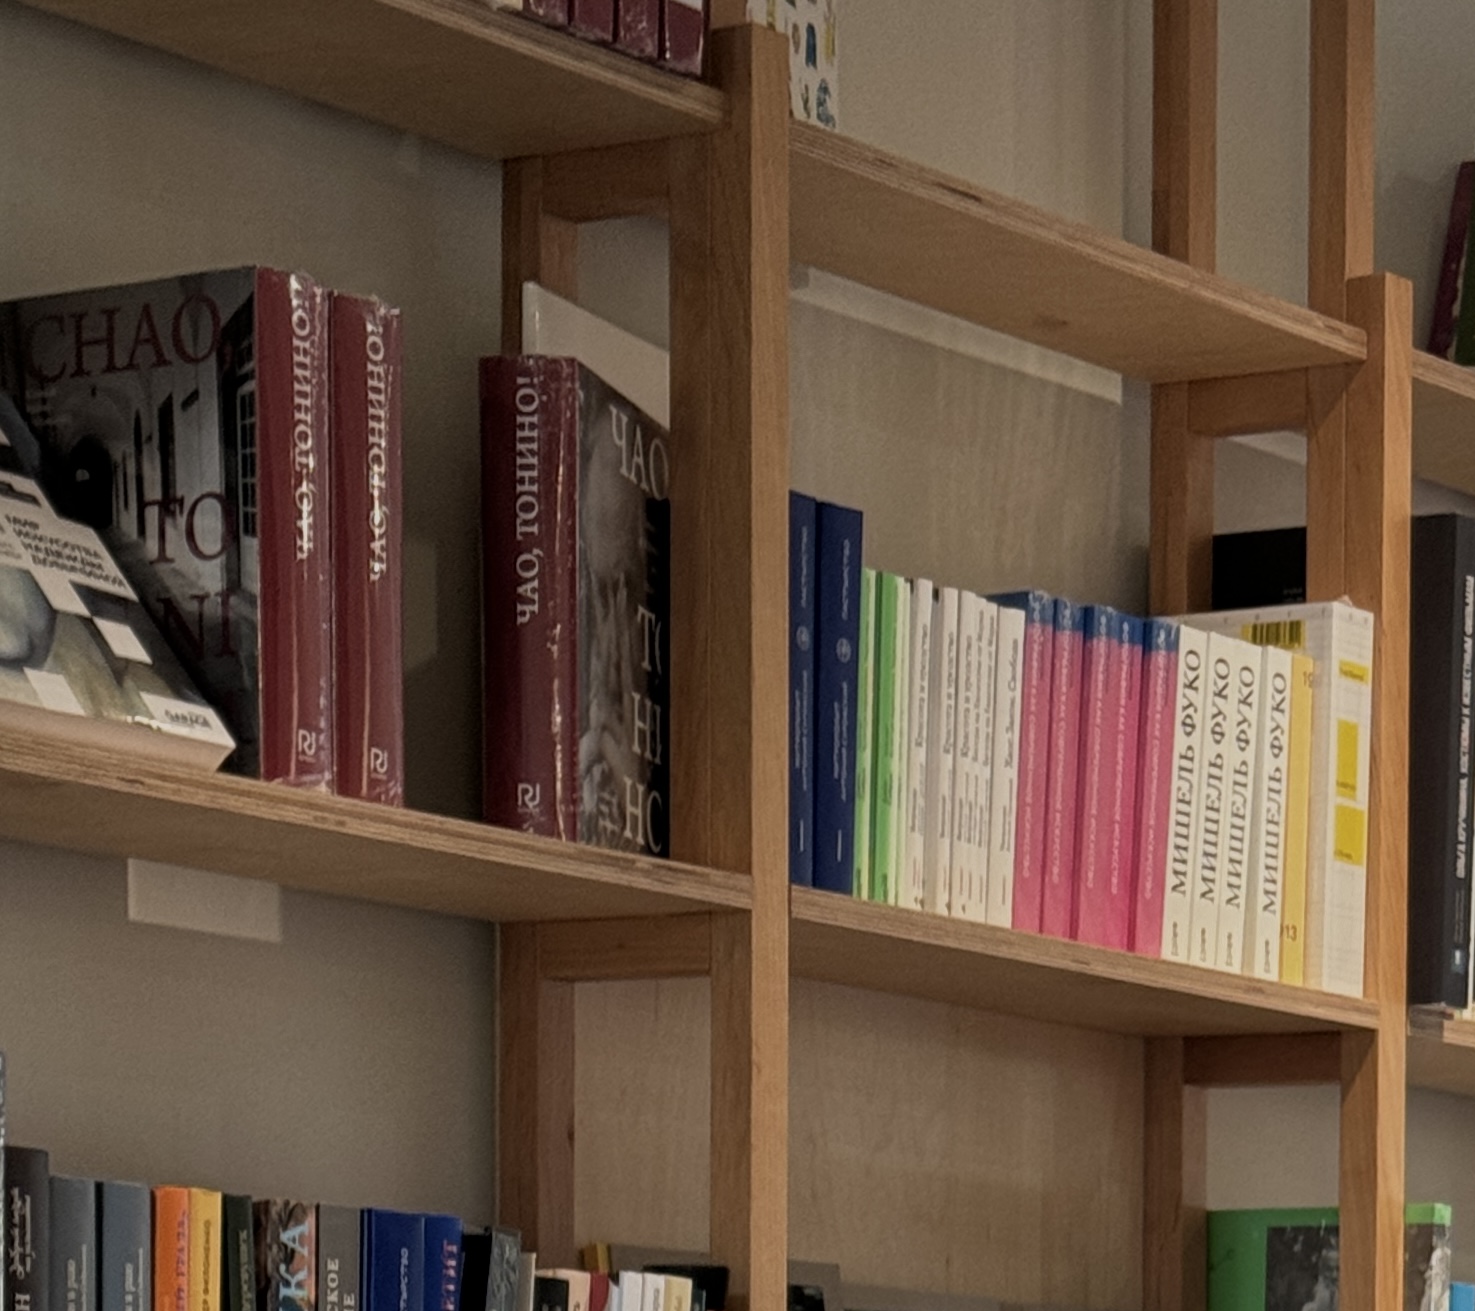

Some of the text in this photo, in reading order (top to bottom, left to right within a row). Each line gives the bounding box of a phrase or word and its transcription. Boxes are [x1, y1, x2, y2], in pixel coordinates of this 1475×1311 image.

[516, 374, 543, 626] ТОНИНО! ЧАО,
[1170, 648, 1202, 897] МИШЕЛЬ ФУКО
[1199, 655, 1231, 904] МИШЕЛЬ ФУКО
[1225, 663, 1256, 910] МИШЕЛЬ ФУКО
[1261, 670, 1287, 915] МИШЕЛЬ ФУКО
